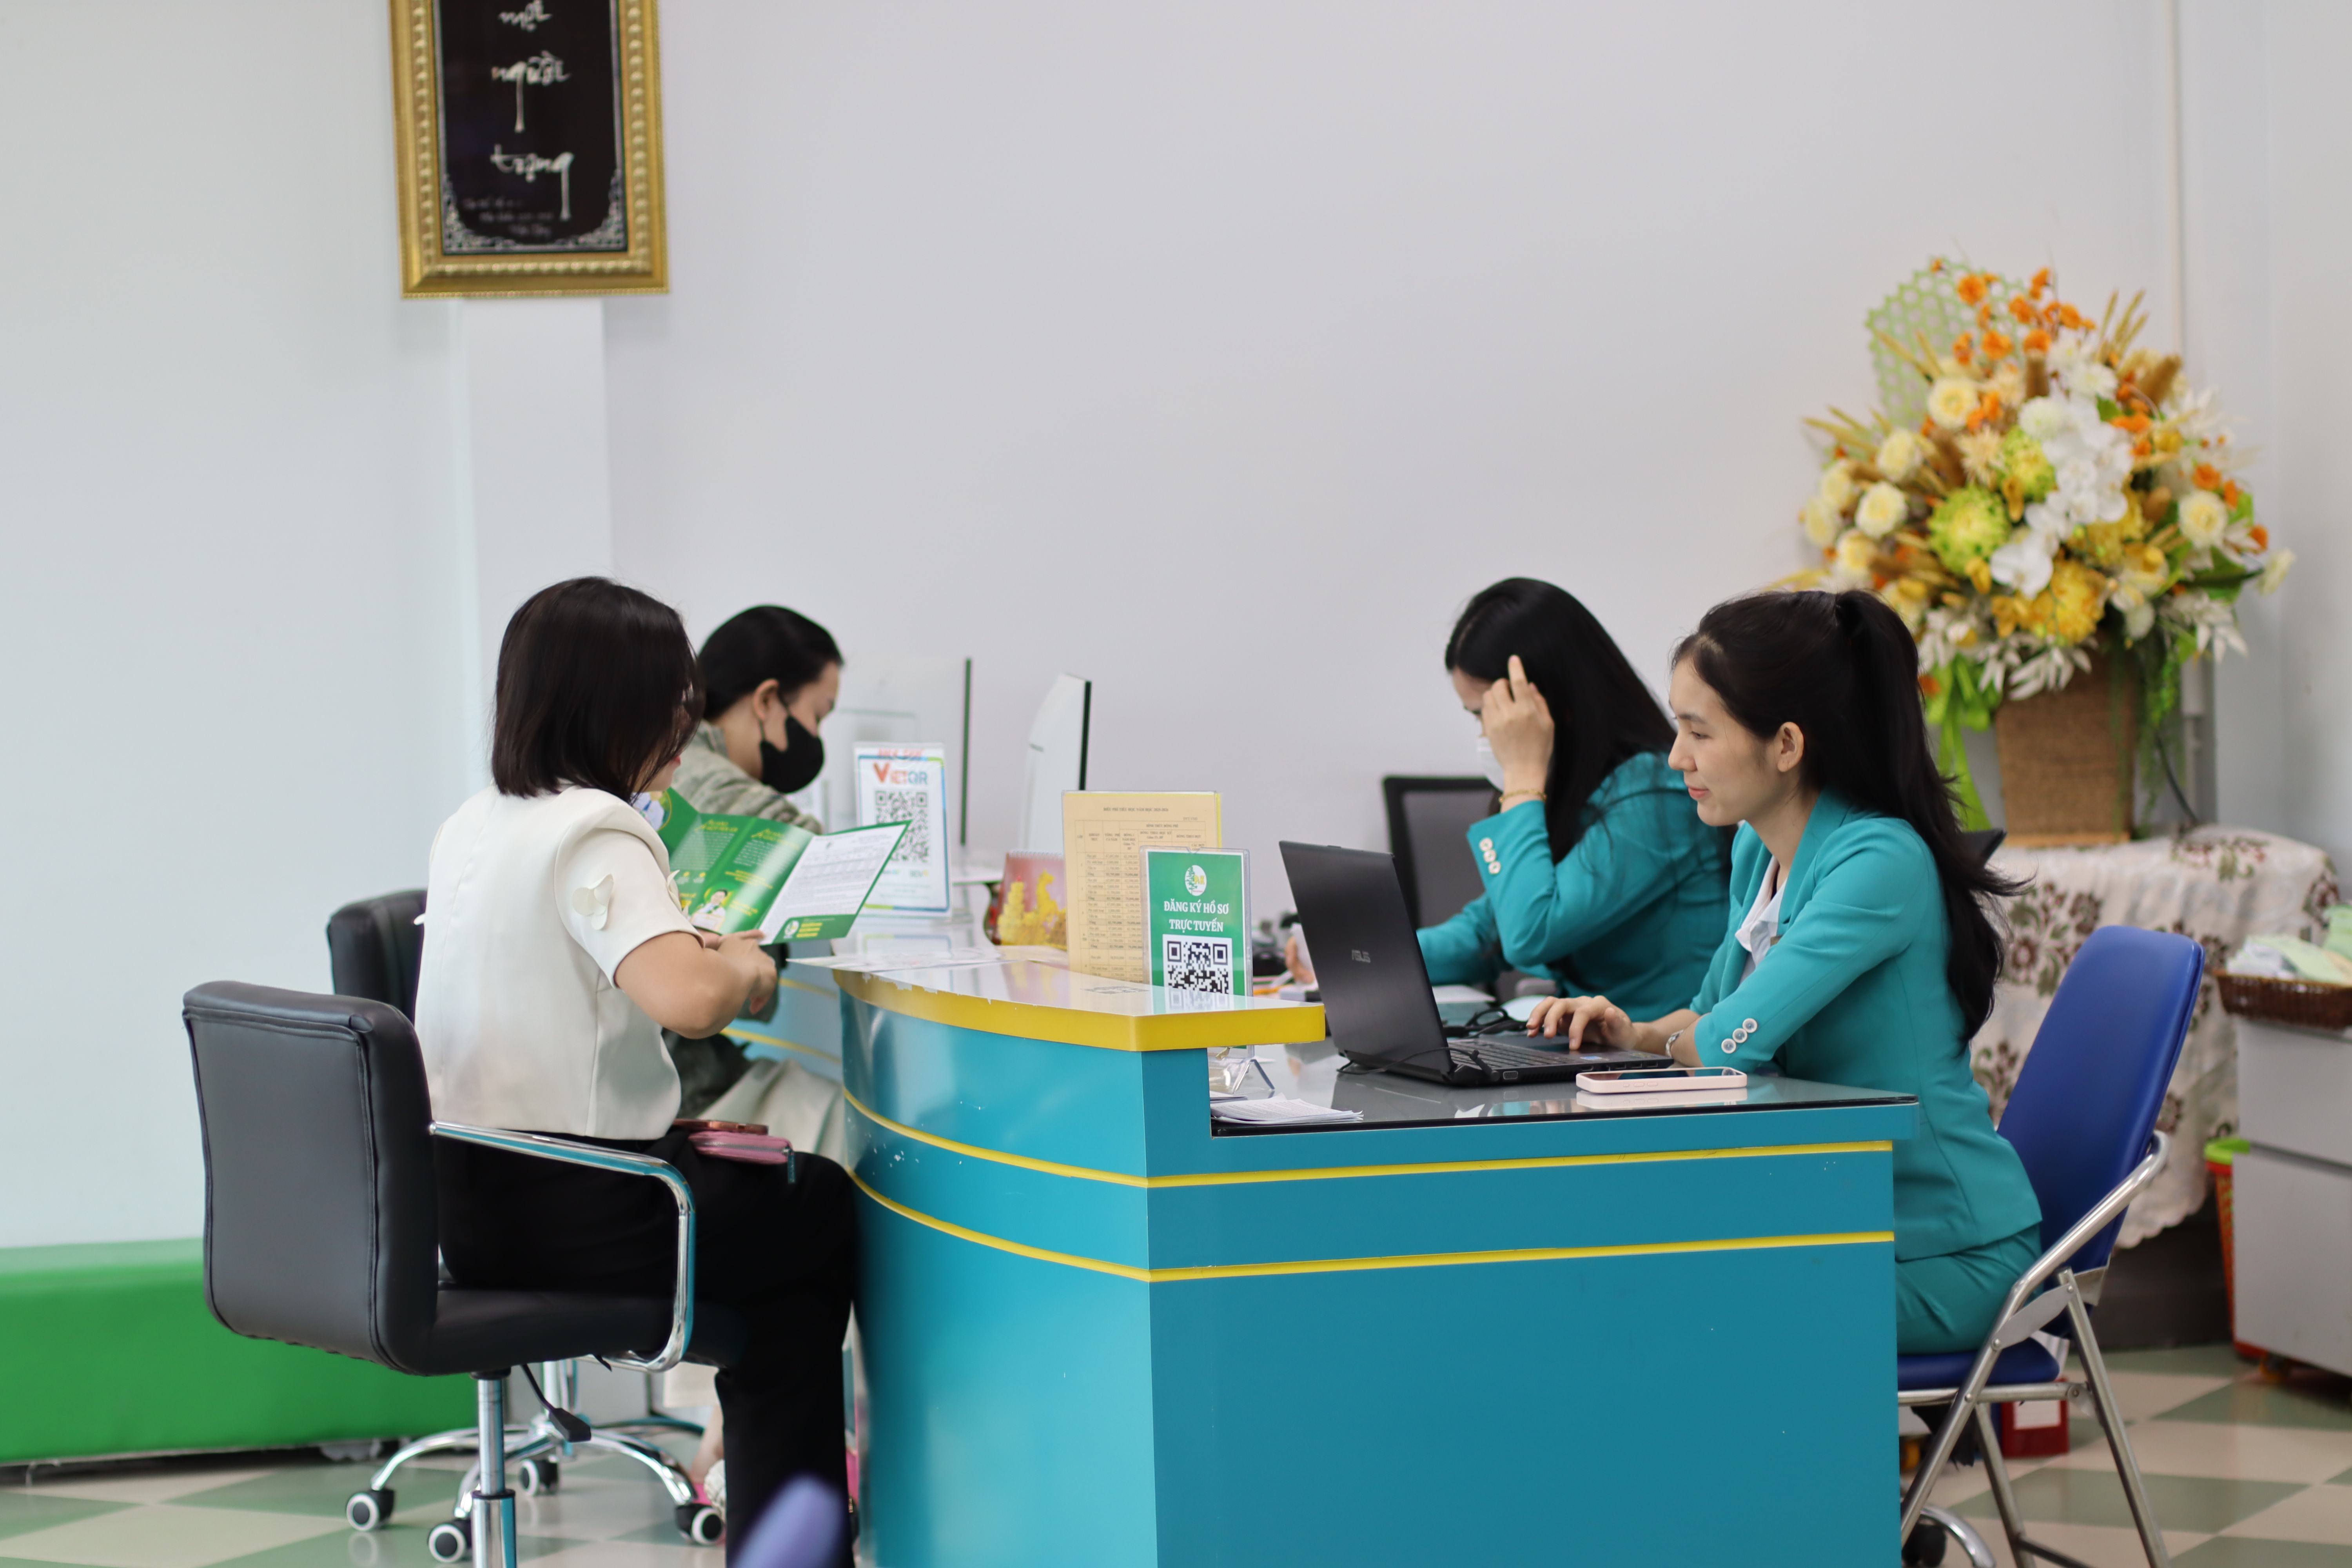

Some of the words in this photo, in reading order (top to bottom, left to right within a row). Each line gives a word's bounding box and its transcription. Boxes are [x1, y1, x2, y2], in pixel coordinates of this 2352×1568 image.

[1164, 898, 1188, 912] ĐĂNG
[1190, 899, 1202, 913] KÝ
[1203, 900, 1216, 913] HỒ
[1217, 903, 1229, 914] SƠ
[1169, 919, 1192, 933] TRỰC
[1194, 917, 1223, 932] TUYẾN
[1352, 949, 1371, 963] ASUS
